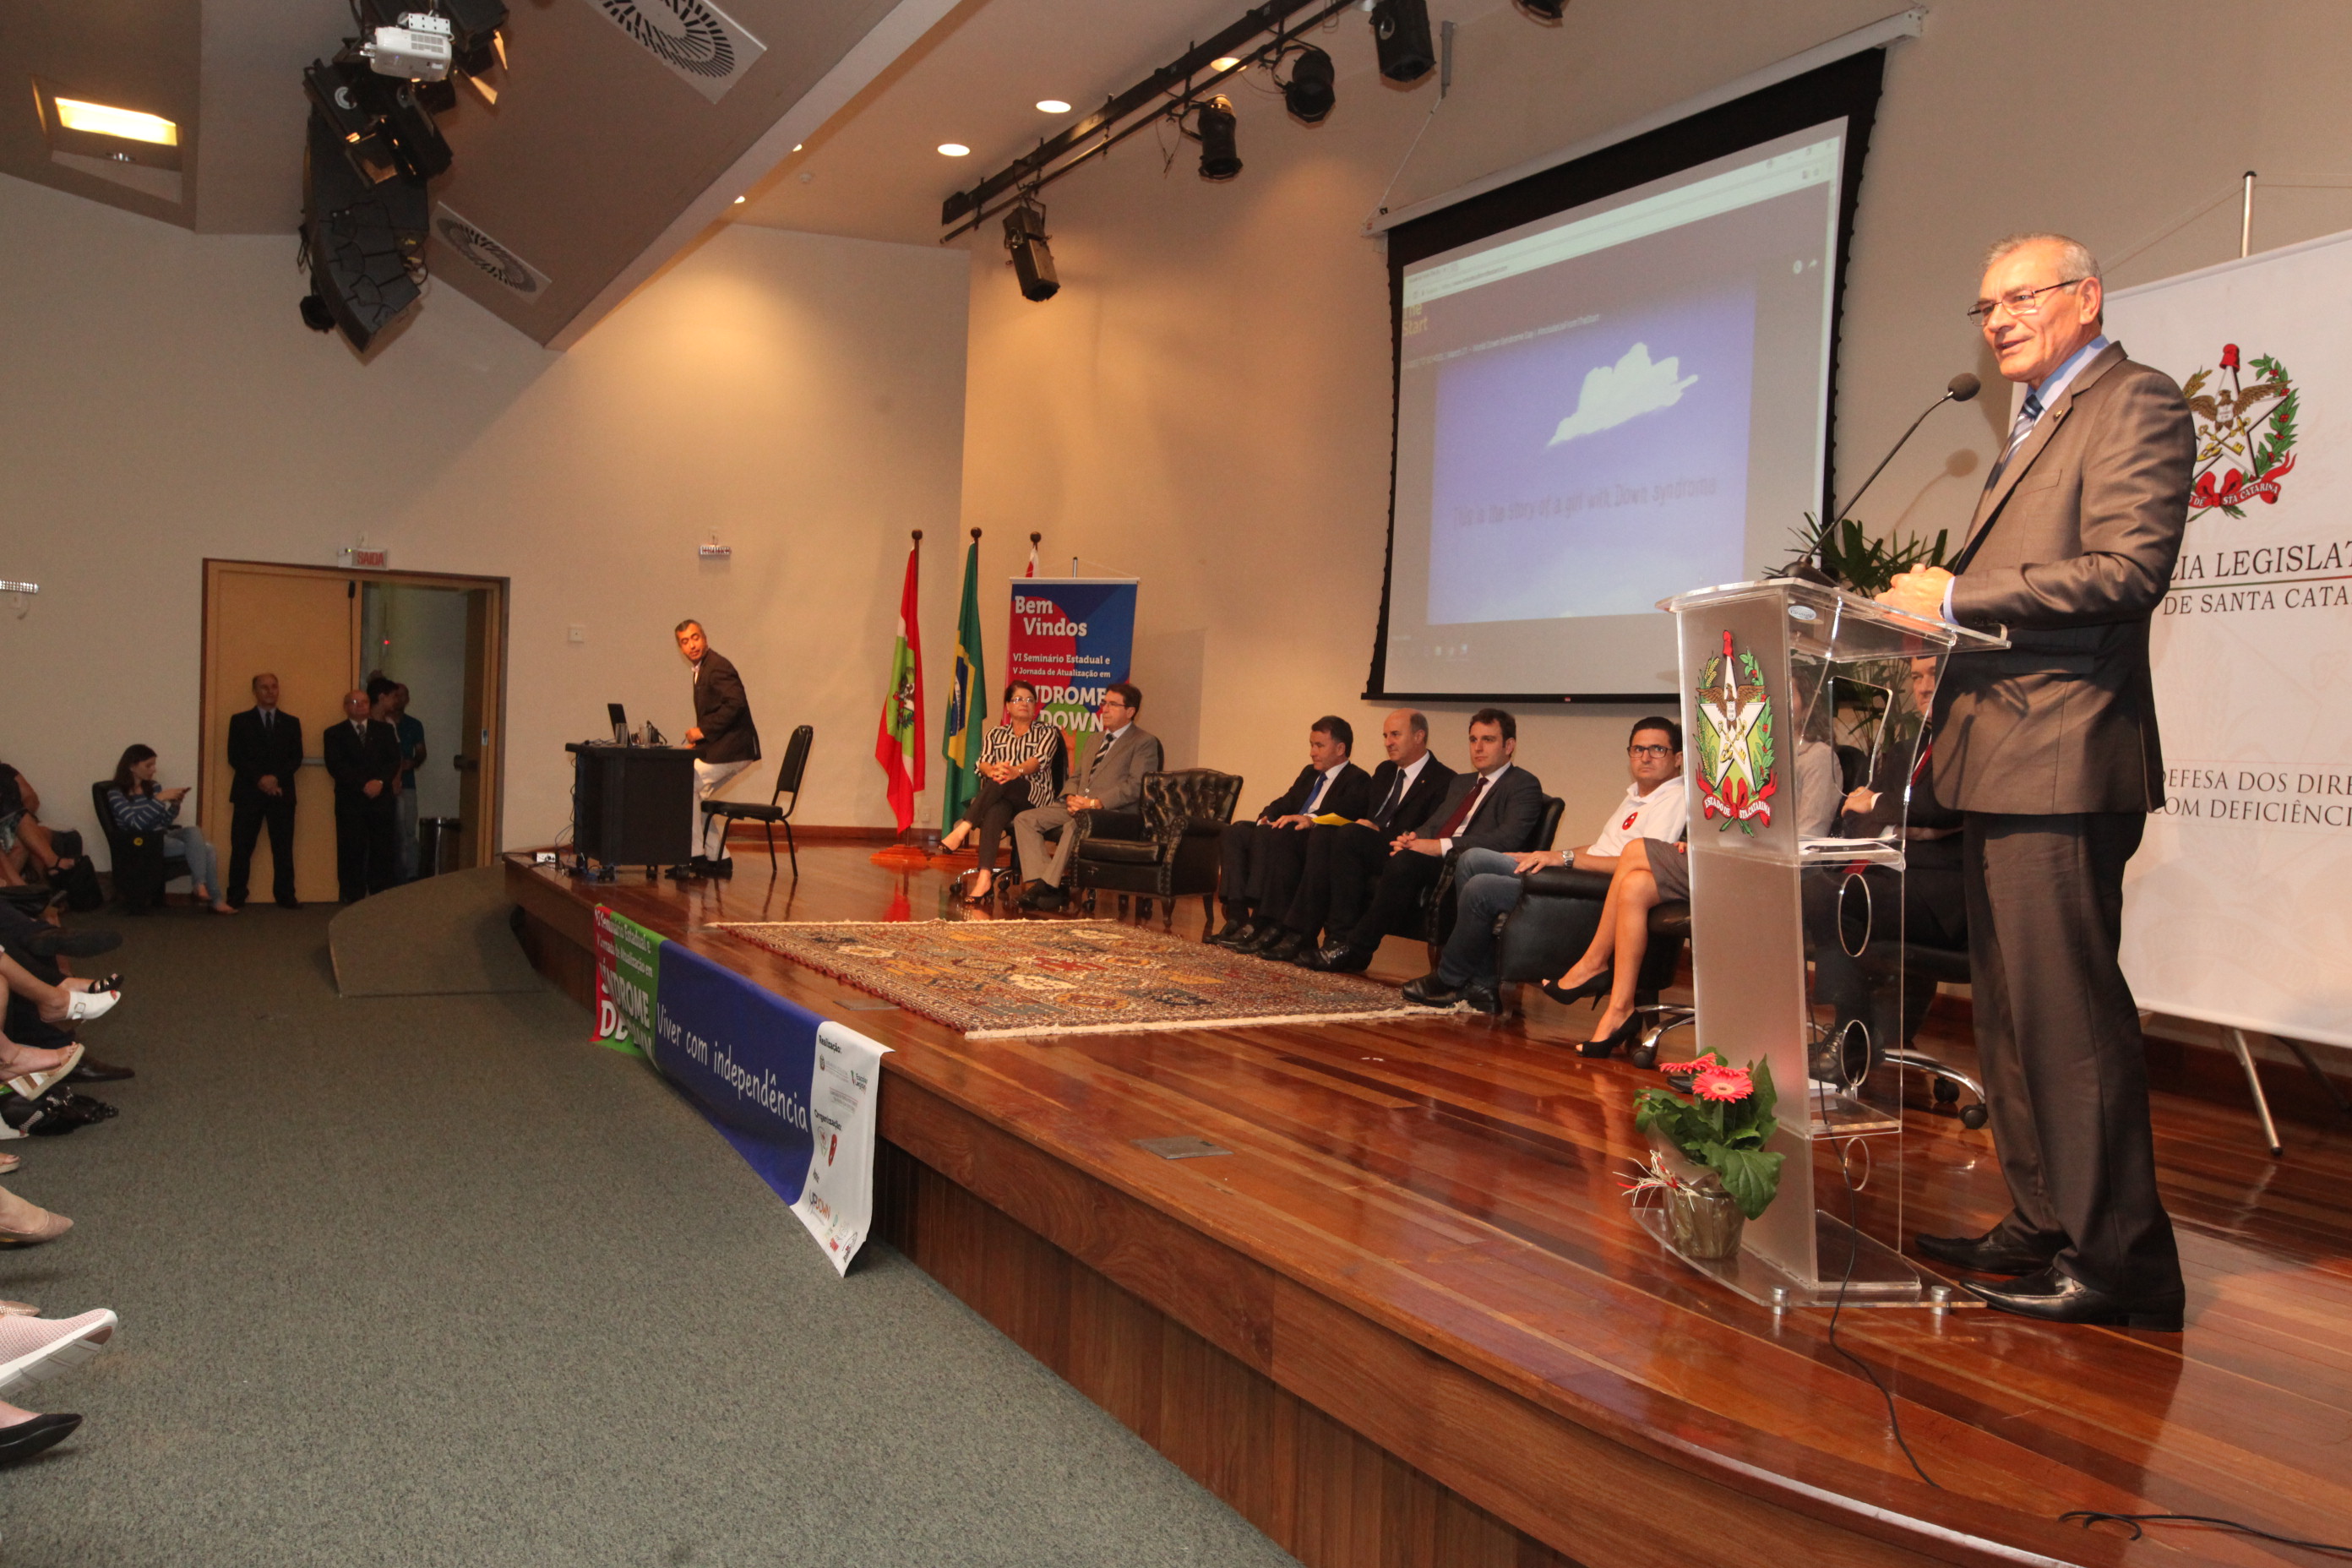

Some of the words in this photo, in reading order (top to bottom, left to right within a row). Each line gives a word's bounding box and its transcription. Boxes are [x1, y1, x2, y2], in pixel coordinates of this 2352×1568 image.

[1614, 483, 1648, 507] Down
[2240, 482, 2278, 500] CATARINA
[1015, 595, 1053, 614] Bem
[2164, 596, 2192, 615] DE
[2201, 591, 2275, 613] SANTA
[2285, 585, 2352, 608] CATA
[1023, 617, 1087, 637] Vindos
[1013, 652, 1021, 662] VI
[1023, 653, 1064, 663] Seminário
[1066, 654, 1103, 665] Estadual
[1019, 667, 1046, 676] Jornada
[1057, 668, 1098, 679] Atualização
[2239, 771, 2288, 792] DOS
[1704, 797, 1723, 811] ESTADO
[1723, 807, 1731, 817] DE
[1747, 801, 1771, 817] CATARINA
[657, 1002, 682, 1047] Viver
[686, 1031, 708, 1066] com
[714, 1041, 808, 1133] independência
